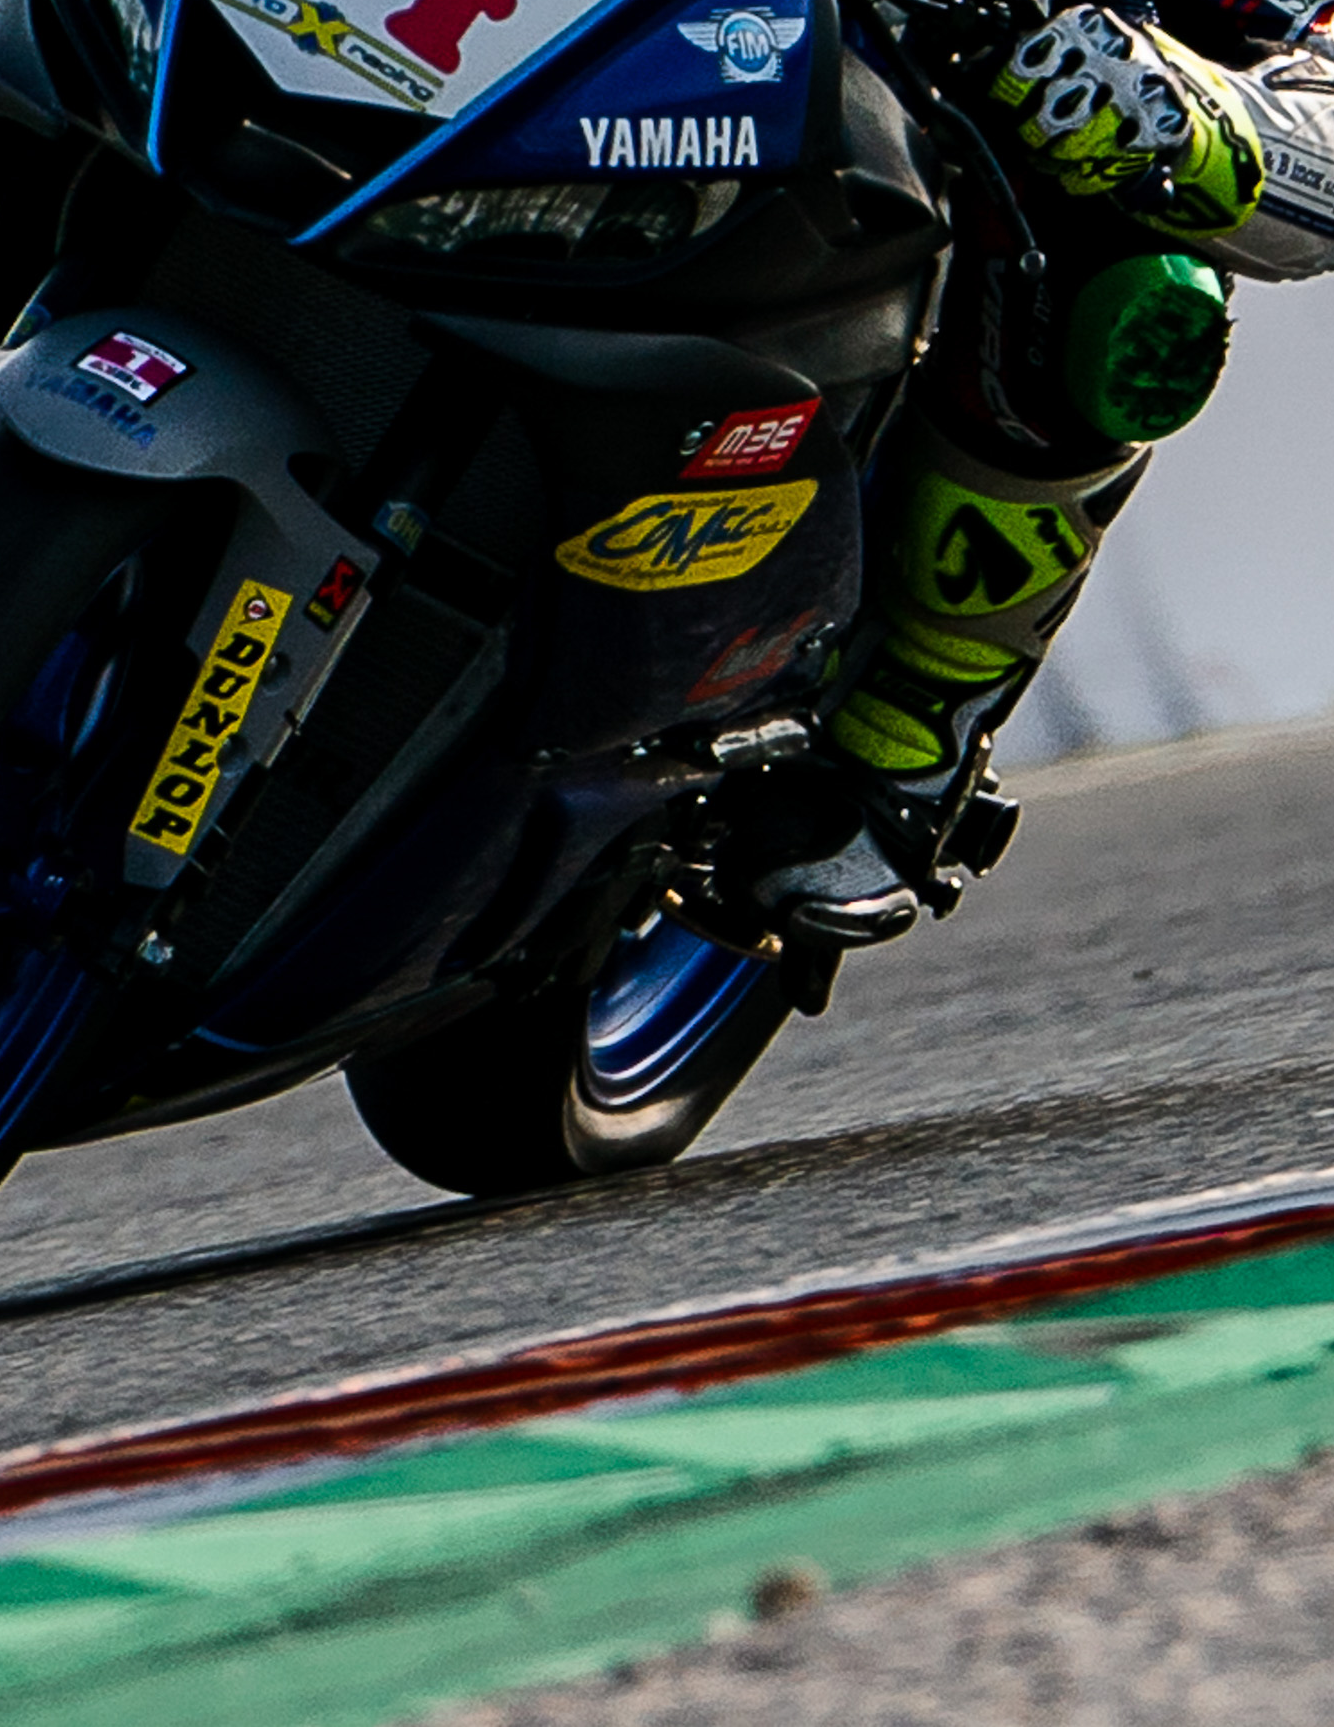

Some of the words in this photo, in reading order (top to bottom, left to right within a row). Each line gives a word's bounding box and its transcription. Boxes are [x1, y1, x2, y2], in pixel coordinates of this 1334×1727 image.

[725, 30, 772, 61] FIM
[580, 115, 760, 168] YAMAHA
[134, 631, 267, 839] DUNLOP
